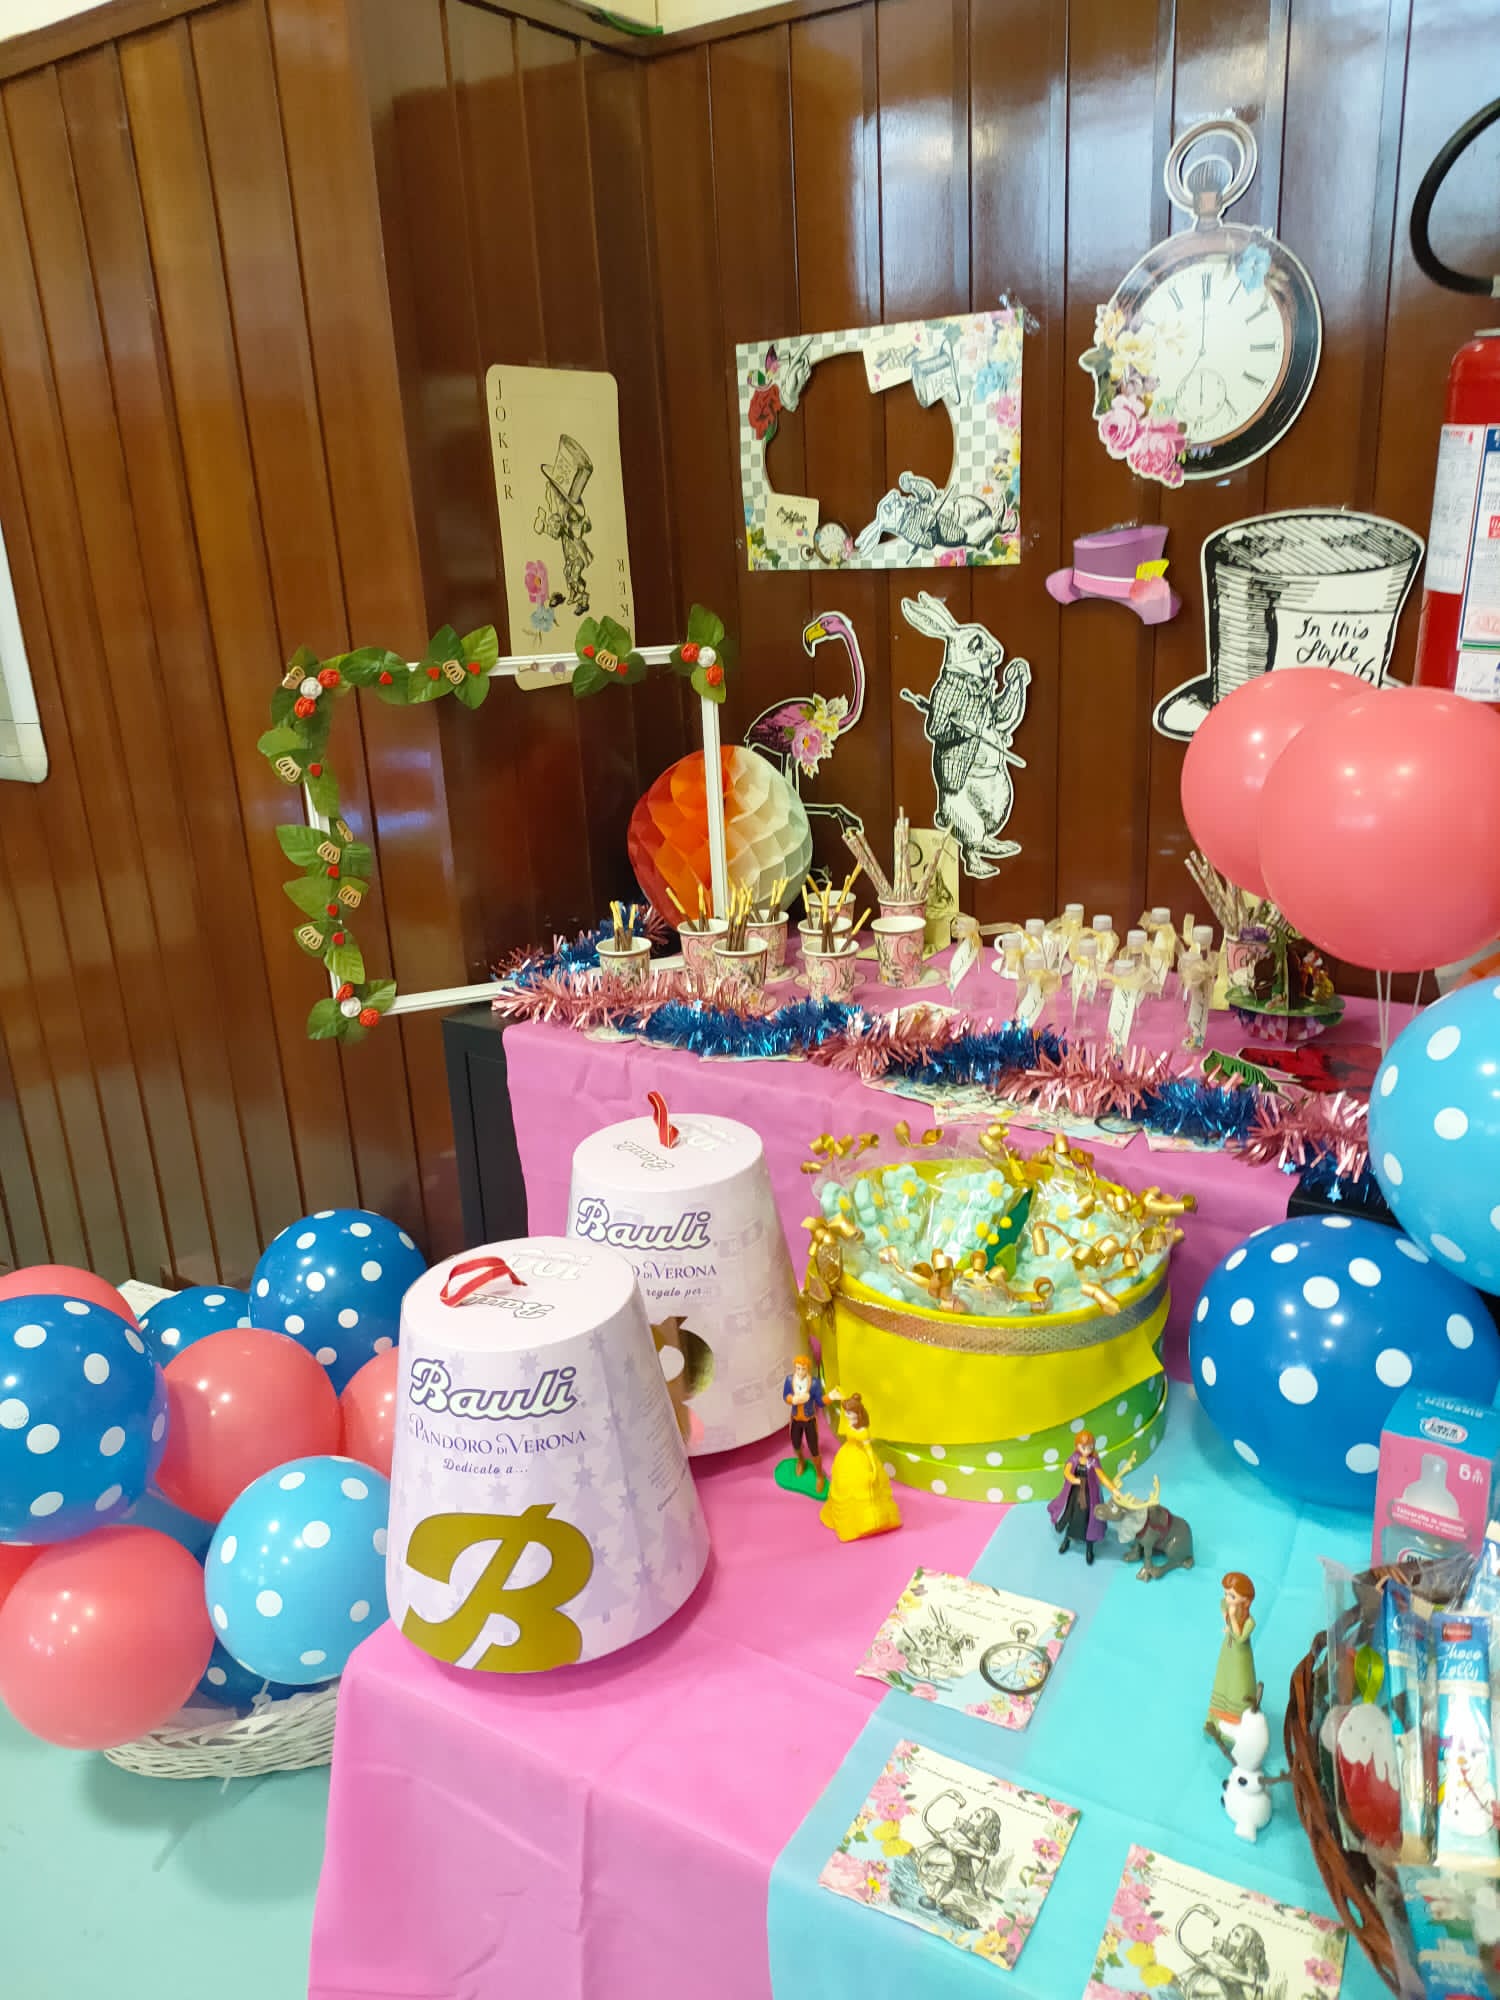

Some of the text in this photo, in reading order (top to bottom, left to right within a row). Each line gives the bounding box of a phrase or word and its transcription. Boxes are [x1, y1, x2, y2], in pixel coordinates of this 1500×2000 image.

[1295, 616, 1369, 639] In this
[575, 1197, 712, 1251] Bauli
[643, 1261, 718, 1280] VERONA
[408, 1357, 578, 1421] Bauli
[409, 1413, 493, 1455] PANDORO
[495, 1429, 587, 1454] VERONA
